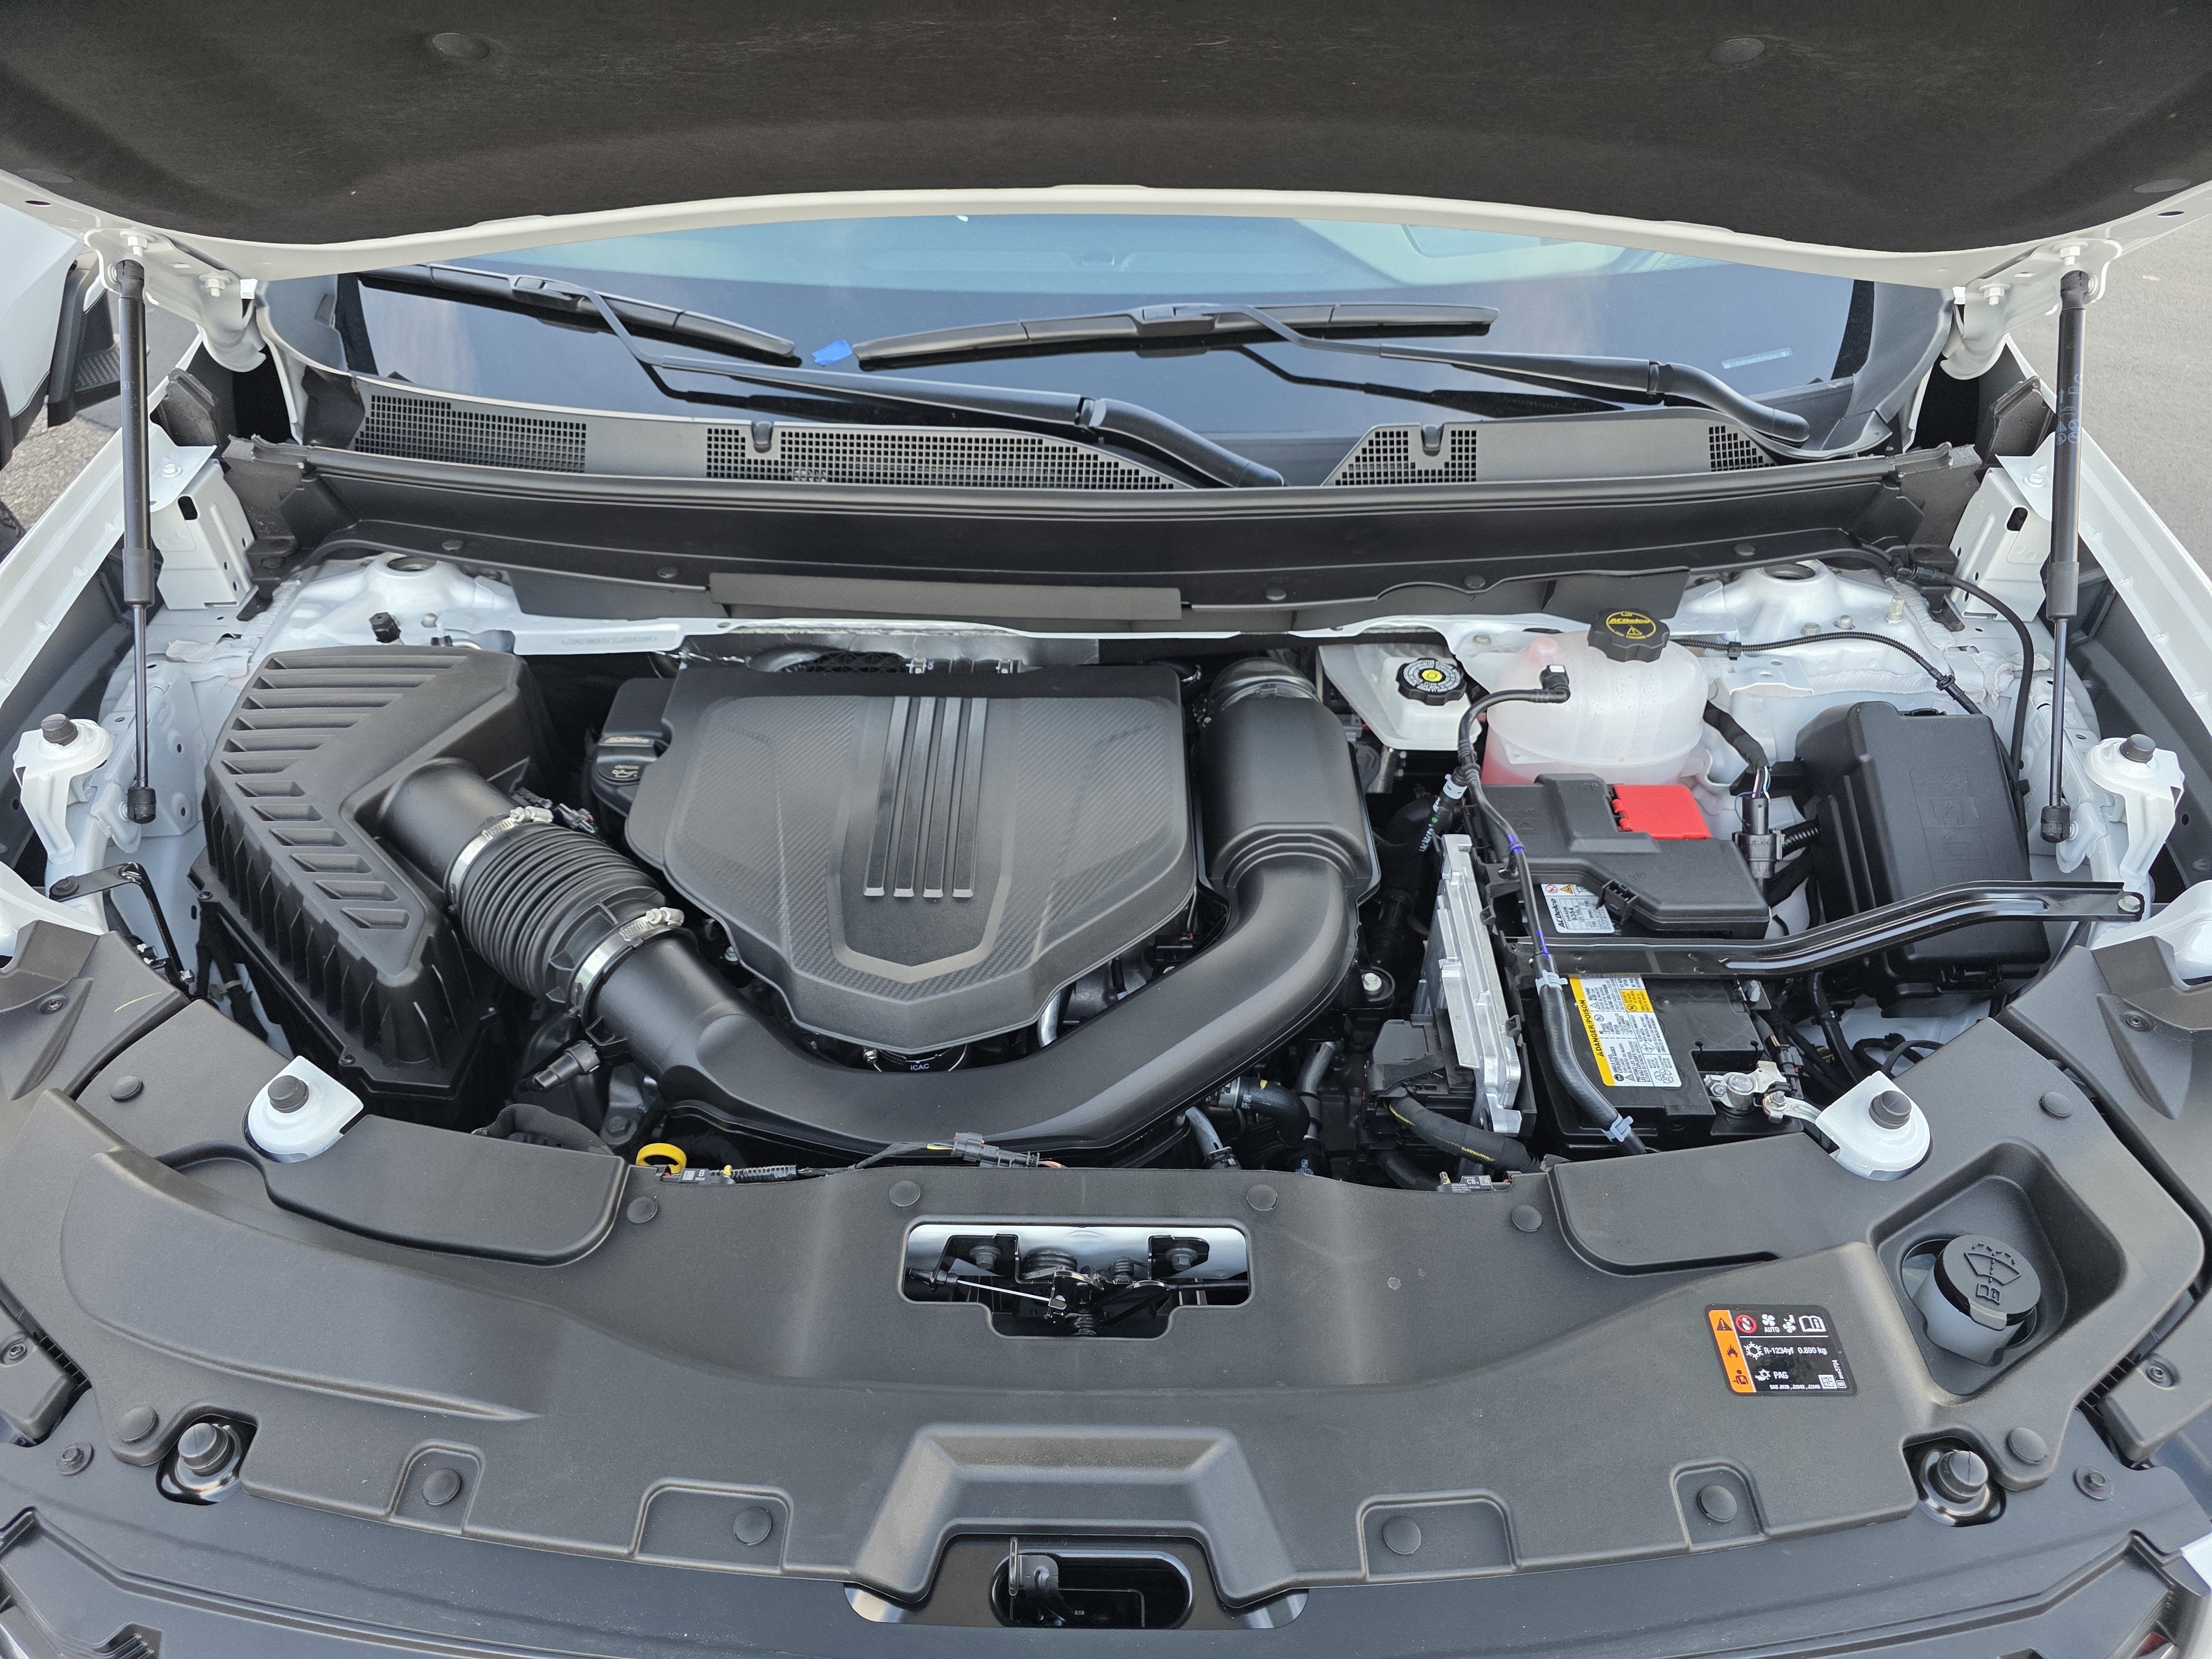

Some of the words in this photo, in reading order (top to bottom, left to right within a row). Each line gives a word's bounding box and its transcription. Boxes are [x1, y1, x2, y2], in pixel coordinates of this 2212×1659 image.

[1551, 898, 1566, 928] ACDelco
[1578, 999, 1602, 1051] DANGER/POISON
[1764, 1347, 1794, 1355] R-1234yf
[1817, 1347, 1828, 1355] kg
